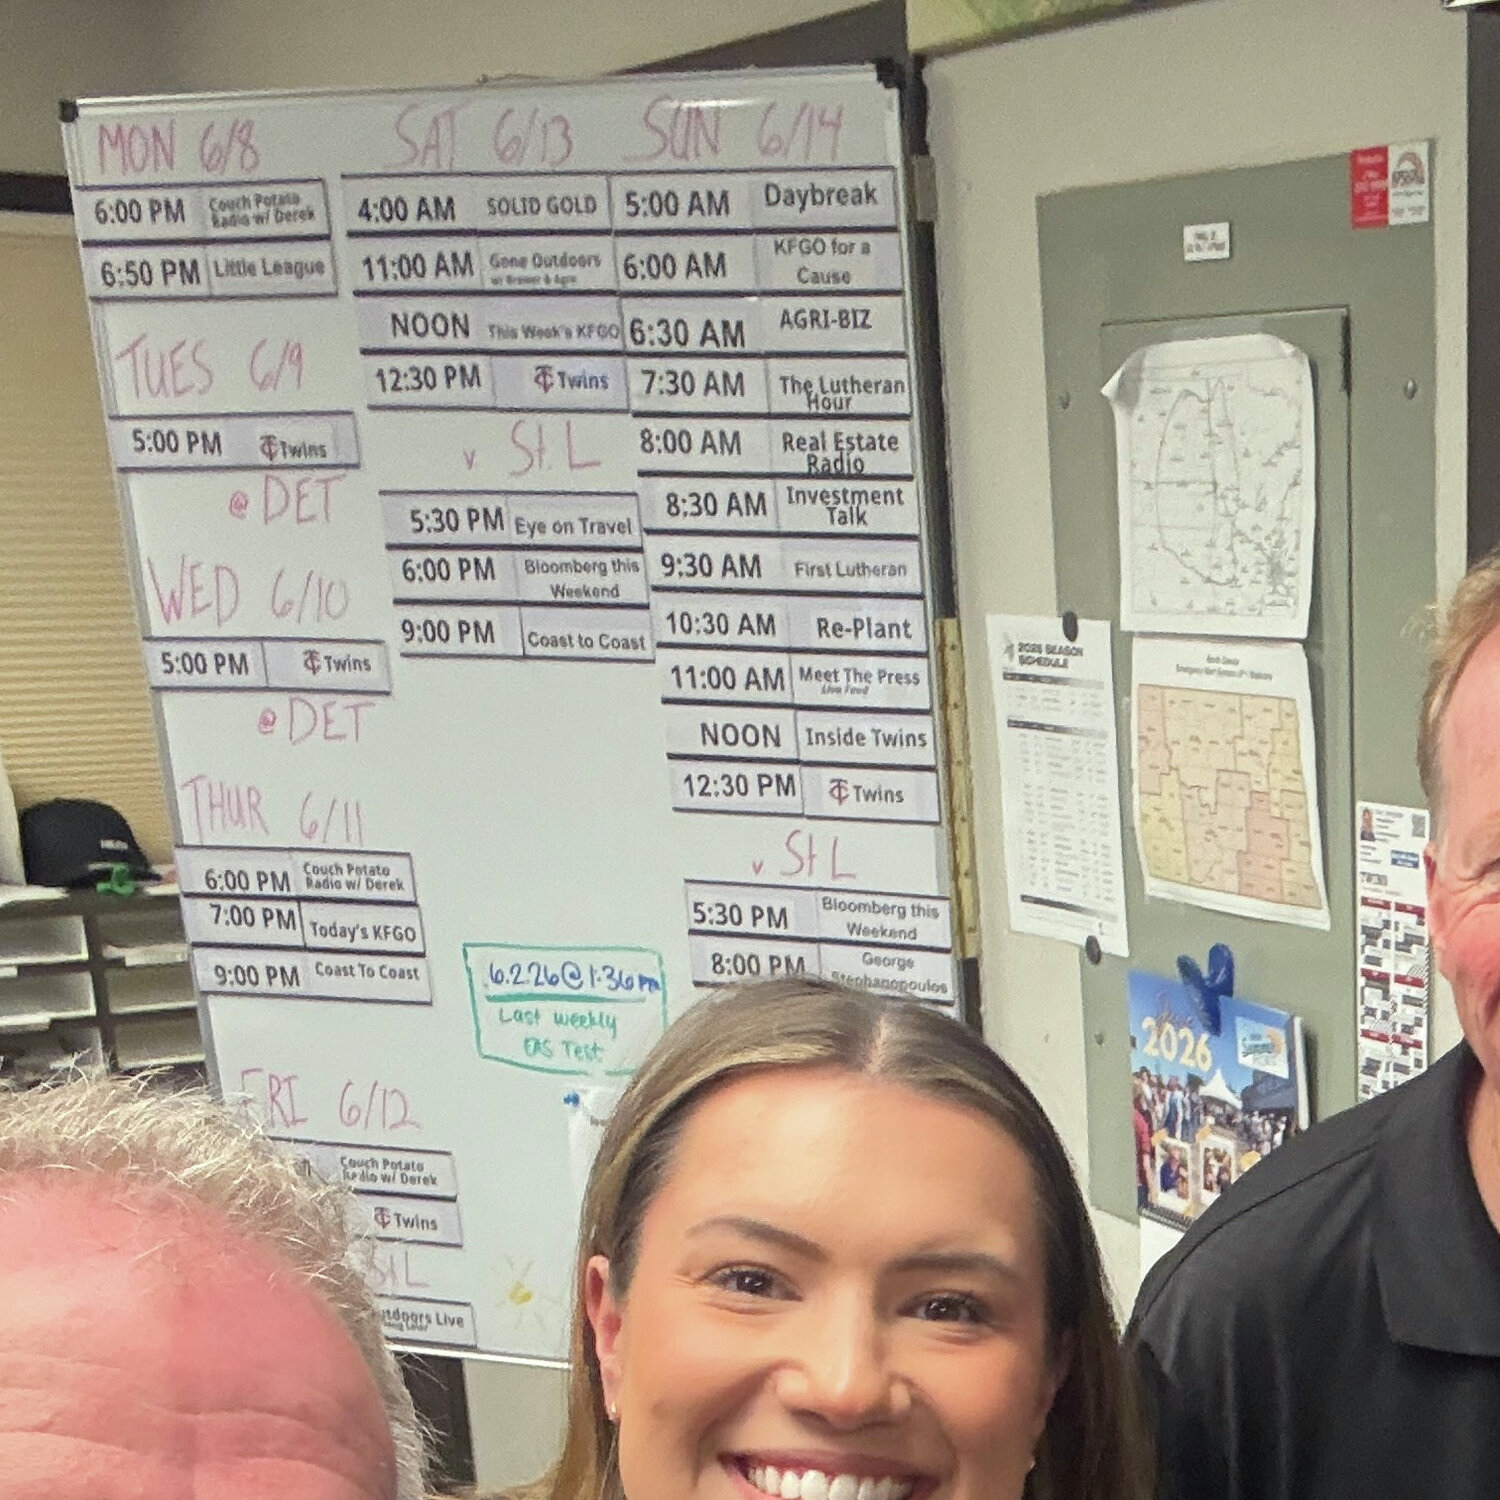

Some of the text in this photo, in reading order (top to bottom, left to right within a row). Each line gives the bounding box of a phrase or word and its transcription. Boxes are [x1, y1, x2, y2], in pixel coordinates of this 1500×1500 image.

[384, 99, 573, 169] SAT 6/13
[623, 95, 844, 161] SUN 6/14
[98, 119, 260, 176] MON 6/8
[487, 194, 597, 216] SOLID GOLD
[625, 190, 730, 217] 5:00 AM
[765, 181, 877, 214] Daybreak
[94, 198, 186, 225] 6:00 PM
[358, 196, 455, 223] 4:00 AM
[774, 238, 871, 255] KFGO for a
[214, 258, 325, 279] Little League
[363, 251, 474, 281] 11:00 AM
[532, 252, 602, 269] Outdoors
[624, 252, 726, 279] 6:00 AM
[101, 258, 200, 287] 6:50 PM
[796, 267, 851, 285] Cause
[391, 312, 469, 338] NOON
[780, 308, 872, 329] AGRI-BIZ
[630, 318, 744, 348] 6:30 AM
[116, 333, 304, 399] TUES 6/9
[376, 364, 481, 392] 12:30 PM
[558, 370, 609, 390] Twins
[641, 369, 745, 397] 7:30 AM
[780, 375, 905, 395] The Lutheran
[807, 394, 852, 411] Hour
[132, 429, 222, 456] 5:00 PM
[280, 440, 327, 459] Twins
[640, 428, 742, 455] 8:00 AM
[782, 431, 899, 452] Real Estate
[807, 453, 865, 474] Radio
[264, 473, 346, 525] DET
[666, 492, 767, 518] 8:30 AM
[786, 486, 905, 507] Investment
[410, 506, 505, 534] 5:30 PM
[515, 516, 632, 538] Eye on Travel
[827, 507, 868, 527] Talk
[402, 556, 496, 582] 6:00 PM
[525, 558, 640, 576] Bloomberg this
[661, 553, 762, 579] 9:30 AM
[794, 561, 908, 578] First Lutheran
[147, 554, 349, 628] WED 6/10
[550, 583, 620, 599] Weekend
[401, 619, 495, 643] 9:00 PM
[666, 611, 776, 637] 10:30 AM
[817, 616, 914, 640] Re-Plant
[528, 631, 646, 651] Coast to Coast
[161, 652, 249, 675] 5:00 PM
[324, 655, 372, 672] Twins
[671, 665, 785, 692] 11:00 AM
[799, 666, 920, 687] Meet The Press
[290, 697, 376, 745] DET
[700, 723, 781, 747] NOON
[806, 728, 928, 748] Inside Twins
[684, 773, 796, 798] 12:30 PM
[853, 785, 905, 803] Twins
[181, 774, 364, 846] THUR 6/11
[205, 869, 290, 892] 6:00 PM
[303, 862, 390, 877] Couch Potato
[306, 877, 405, 891] Radio w/ Derek
[210, 904, 296, 930] 7:00 PM
[693, 902, 788, 930] 5:30 PM
[822, 897, 940, 919] Bloomberg this
[310, 921, 416, 943] Today's KFGO
[847, 922, 918, 940] Weekend
[316, 962, 420, 981] Coast To Coast
[711, 952, 805, 976] 8:00 PM
[862, 952, 915, 971] George
[214, 965, 300, 988] 9:00 PM
[499, 1007, 617, 1039] Last weekly
[562, 1040, 603, 1062] Test
[1142, 1016, 1213, 1072] 2026
[339, 1079, 421, 1131] 6/12
[340, 1156, 424, 1171] Couch Potato
[400, 1172, 437, 1186] Derek
[393, 1211, 438, 1231] Twins
[436, 1312, 464, 1328] Live
